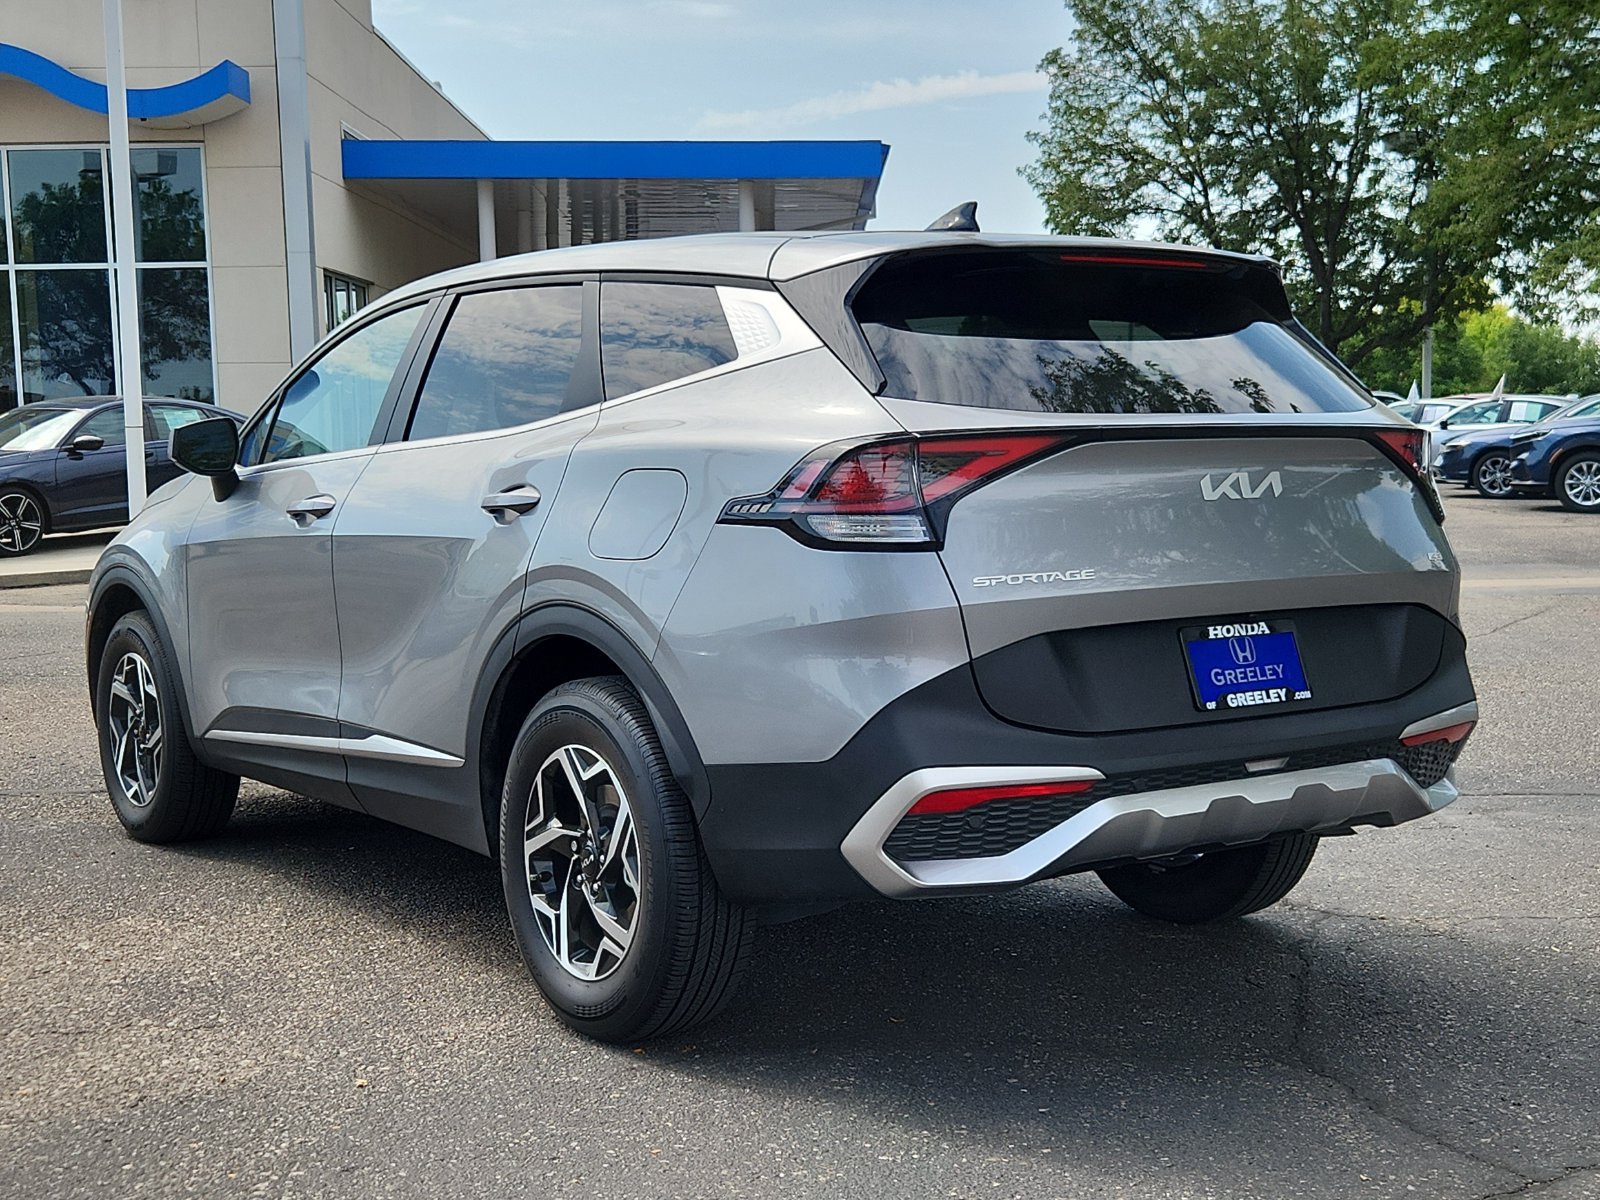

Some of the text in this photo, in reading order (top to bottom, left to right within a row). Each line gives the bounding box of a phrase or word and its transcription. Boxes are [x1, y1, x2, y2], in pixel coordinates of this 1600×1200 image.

[1200, 471, 1283, 501] KIA
[973, 569, 1097, 587] SPORTAGE
[1207, 622, 1270, 639] HONDA
[1211, 664, 1284, 686] GREELEY
[1206, 701, 1217, 710] OF
[1227, 688, 1287, 707] GREELEY
